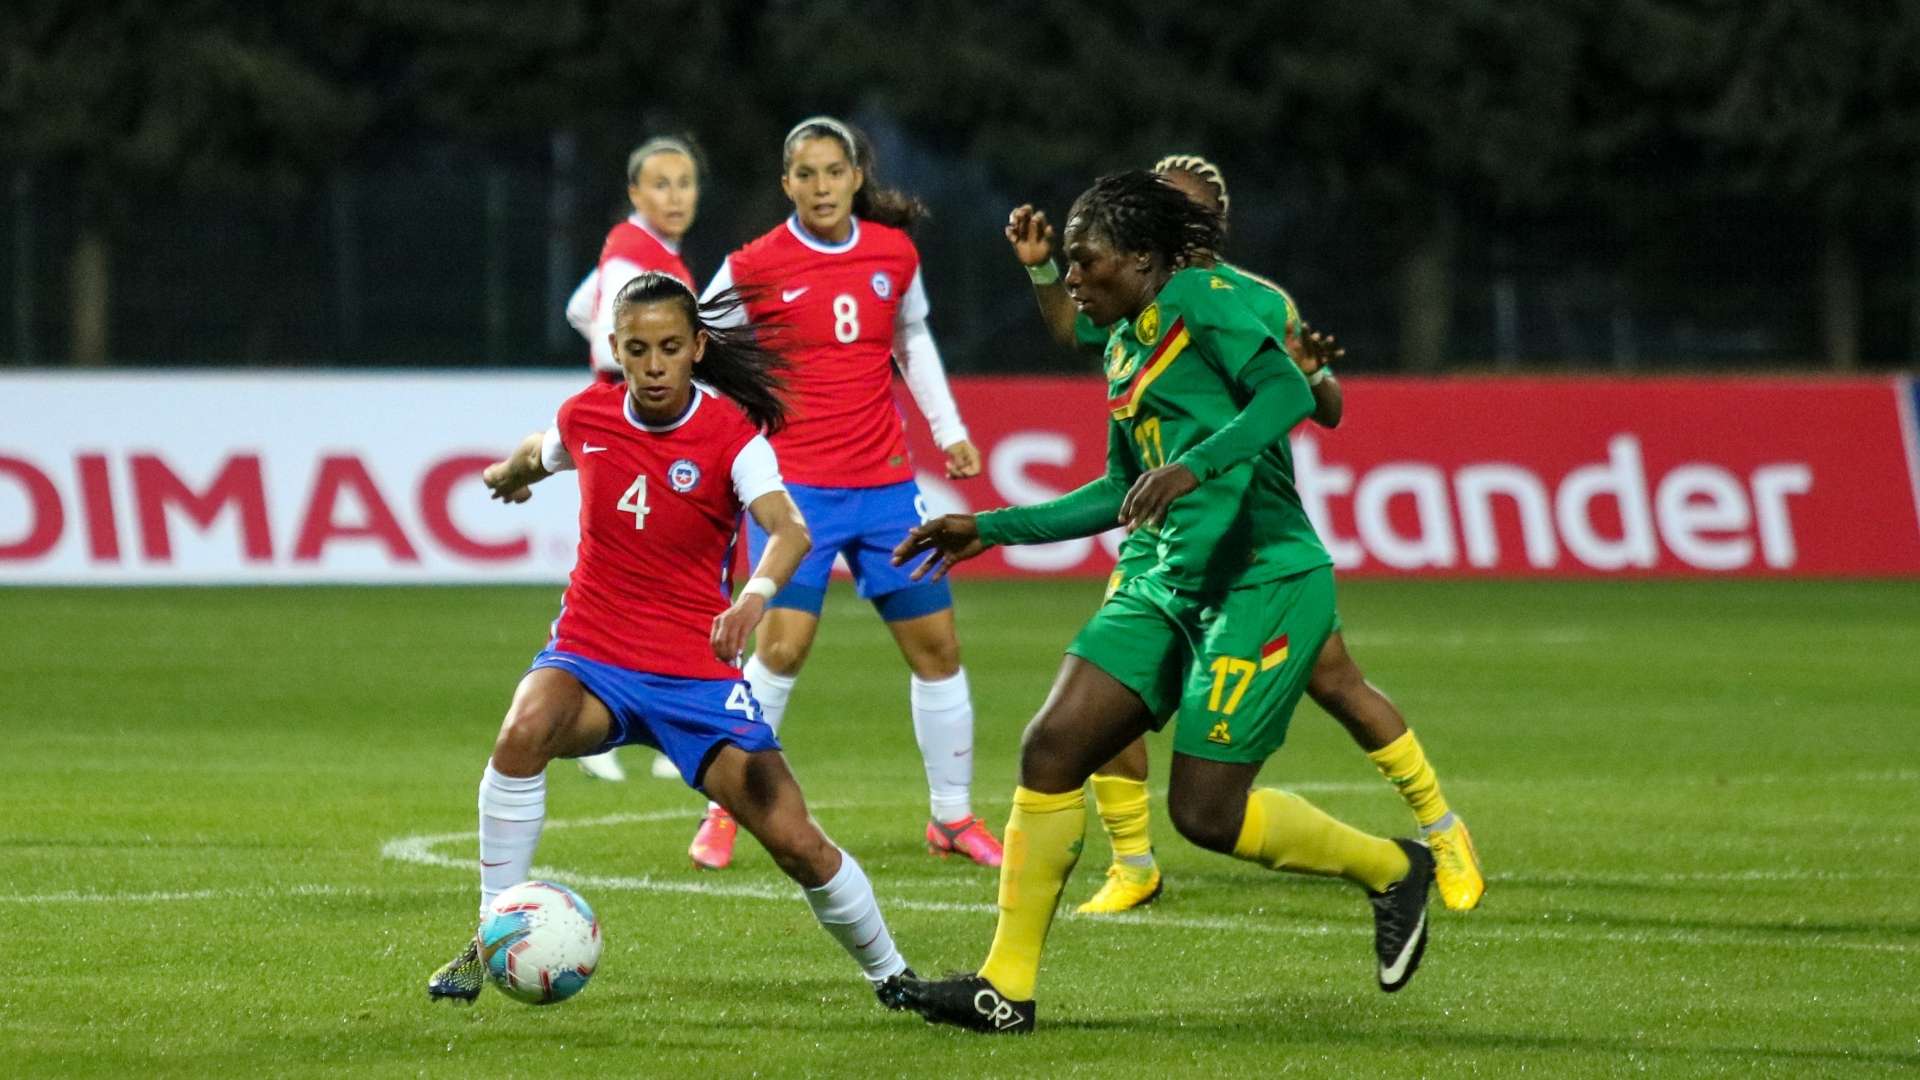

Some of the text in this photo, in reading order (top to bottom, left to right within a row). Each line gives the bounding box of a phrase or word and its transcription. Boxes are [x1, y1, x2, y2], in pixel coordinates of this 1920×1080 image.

[833, 294, 859, 343] 8
[1134, 416, 1164, 469] 17
[616, 475, 650, 530] 4
[989, 432, 1813, 572] Stander
[724, 683, 755, 721] 4
[1207, 655, 1257, 715] 17
[974, 988, 1024, 1030] CR7
